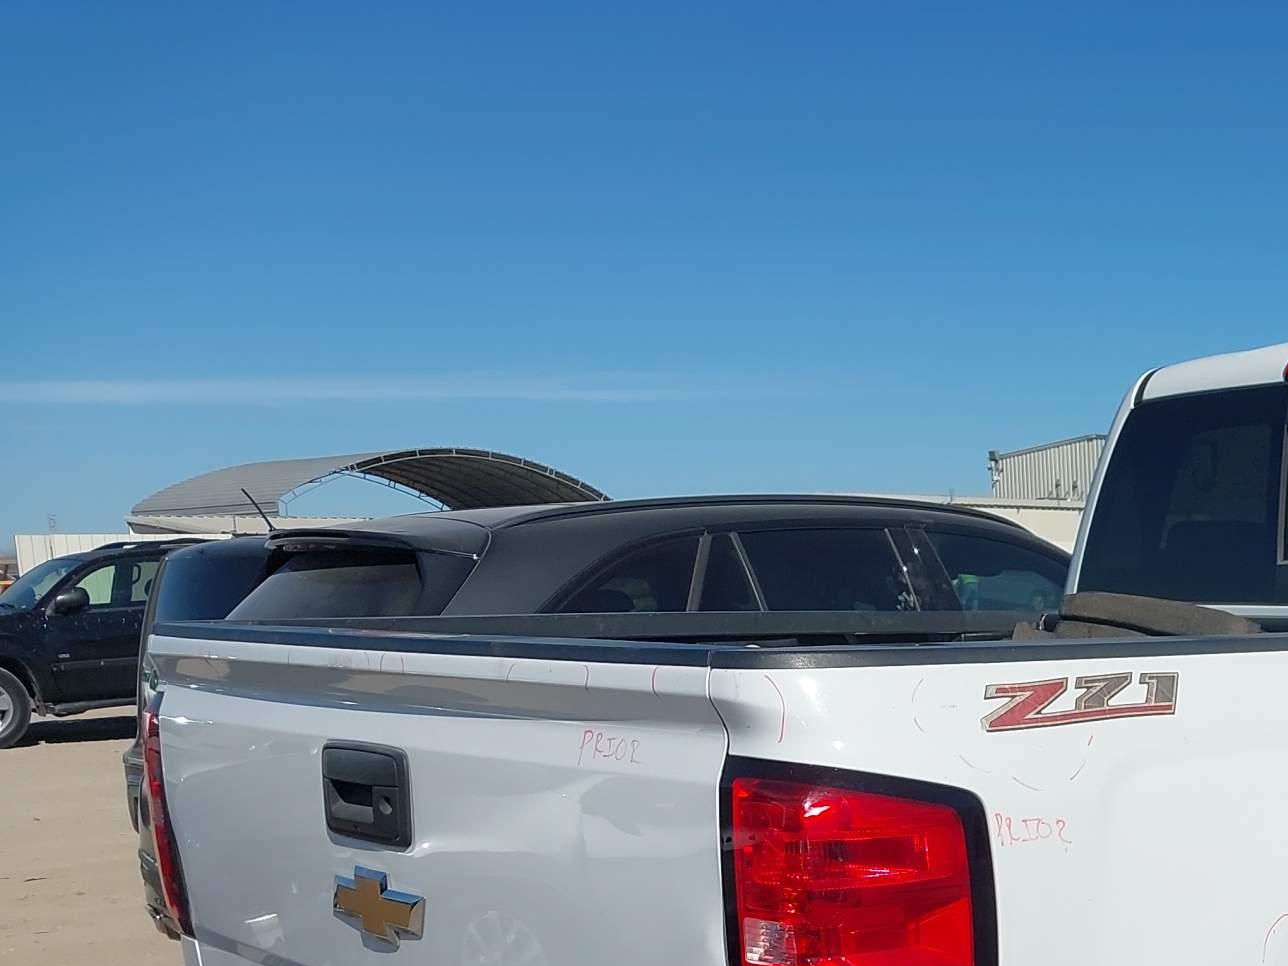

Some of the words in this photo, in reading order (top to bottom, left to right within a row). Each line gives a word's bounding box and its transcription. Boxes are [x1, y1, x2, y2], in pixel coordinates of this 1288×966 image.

[980, 671, 1179, 732] Z71
[577, 729, 641, 766] PRIOR
[994, 812, 1071, 848] PRIOR
